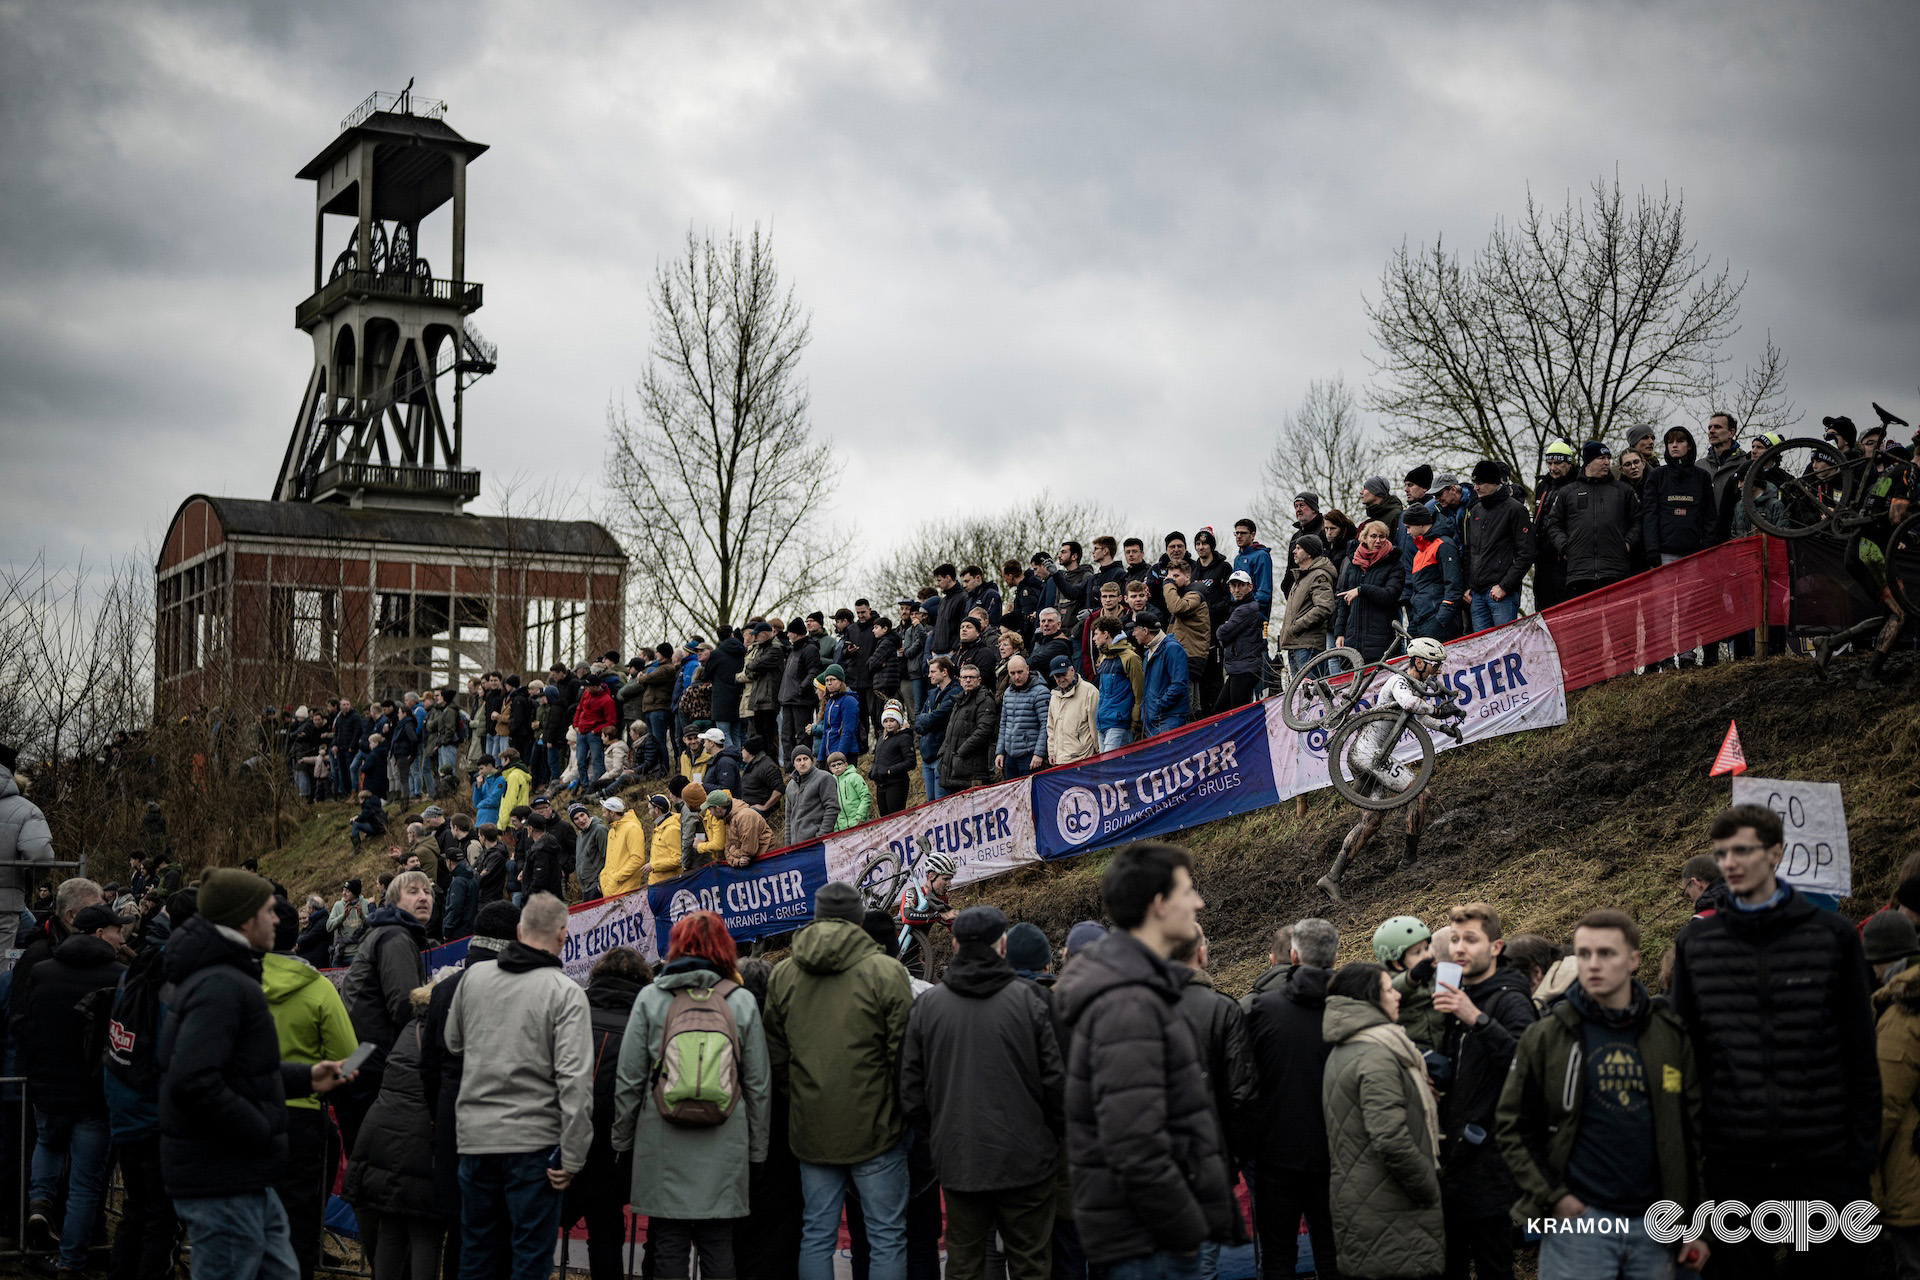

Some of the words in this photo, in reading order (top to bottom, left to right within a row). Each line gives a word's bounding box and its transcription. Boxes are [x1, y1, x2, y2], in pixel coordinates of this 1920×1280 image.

[1433, 652, 1528, 706] USTER
[1098, 778, 1131, 817] DE
[1135, 740, 1239, 804] CEUSTER
[1198, 772, 1241, 797] GRUES
[889, 834, 915, 867] DE
[977, 841, 1013, 862] GRUES
[700, 885, 723, 914] DE
[727, 869, 806, 913] CEUSTER
[722, 911, 767, 929] WKRANEN
[775, 901, 808, 920] GRUES
[565, 932, 581, 962] DE
[586, 912, 647, 957] CEUSTER
